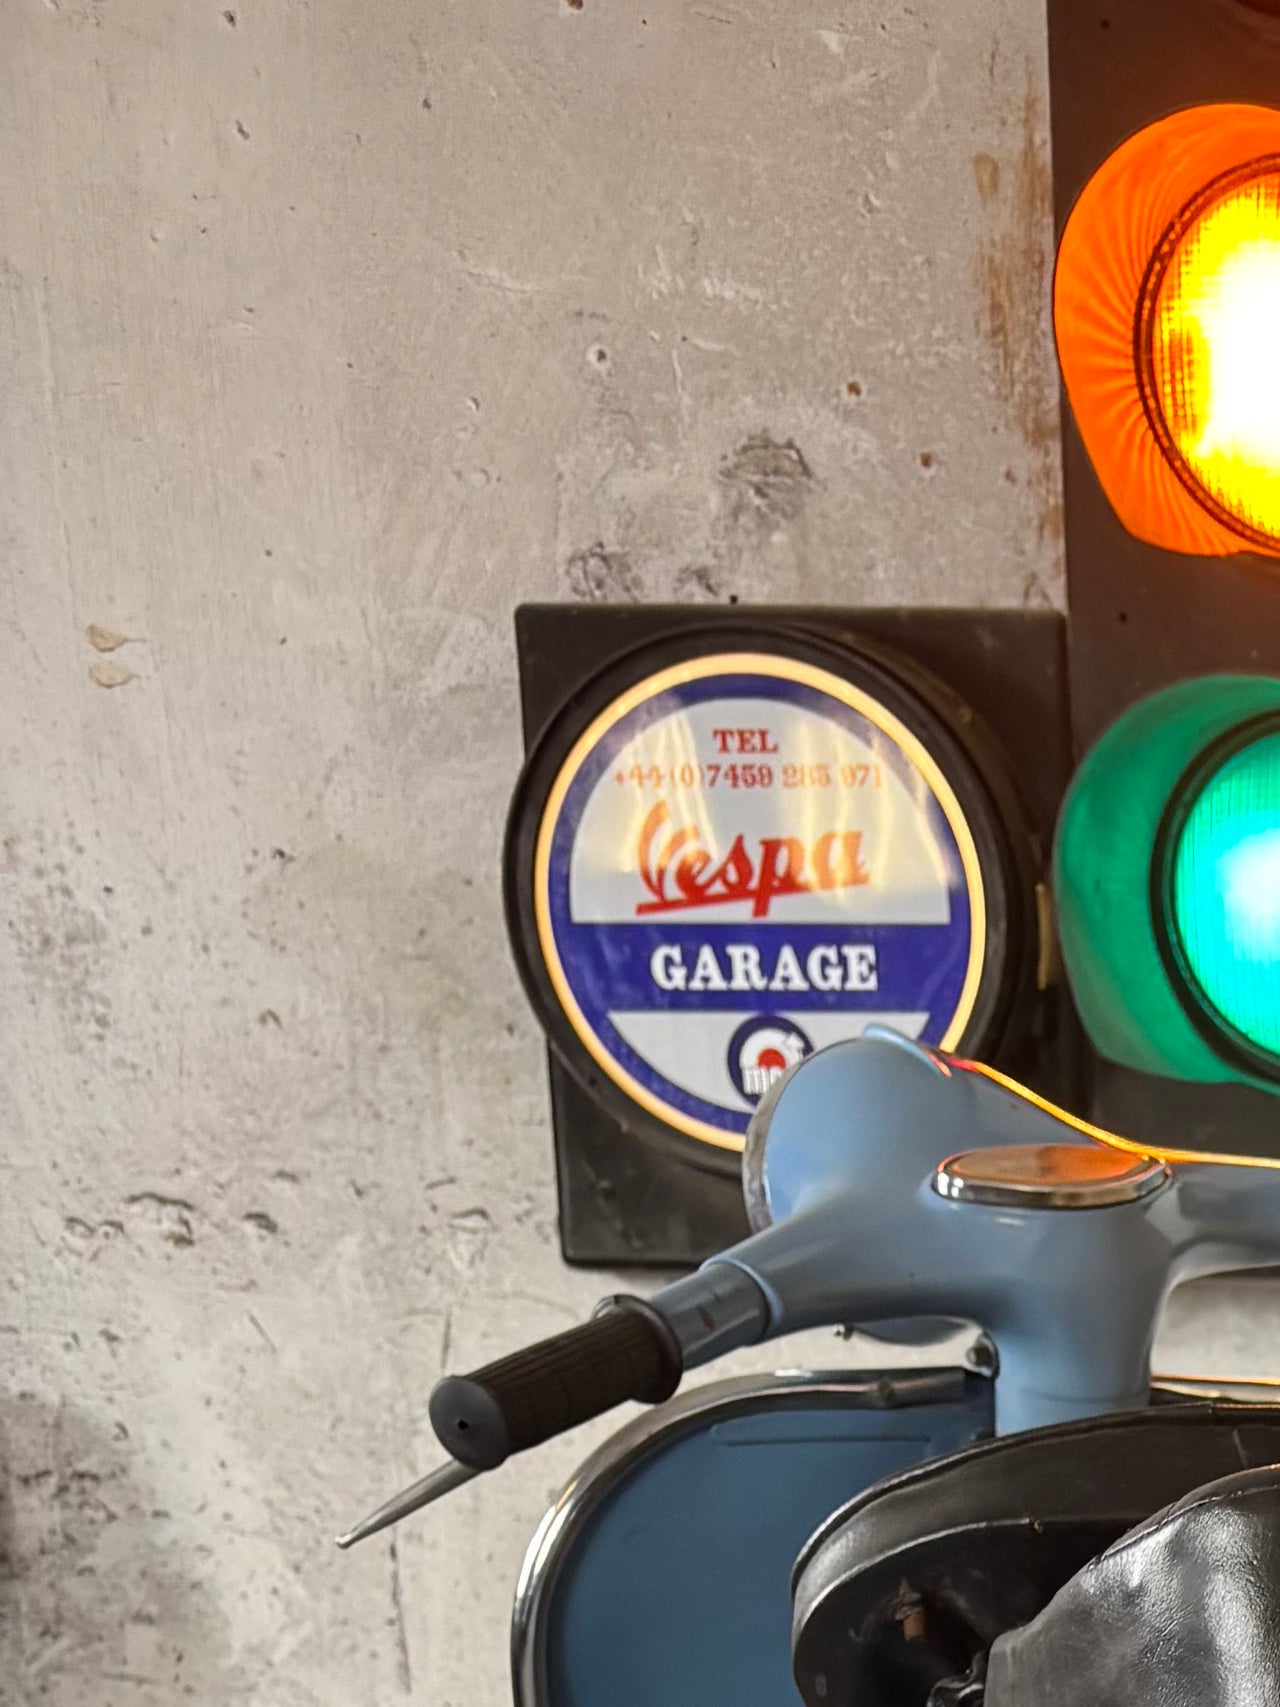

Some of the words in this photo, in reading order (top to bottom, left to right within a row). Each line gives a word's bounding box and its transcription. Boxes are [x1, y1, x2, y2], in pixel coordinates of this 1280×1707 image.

[712, 728, 778, 755] TEL
[636, 801, 870, 918] Vespa
[650, 944, 878, 992] GARAGE
